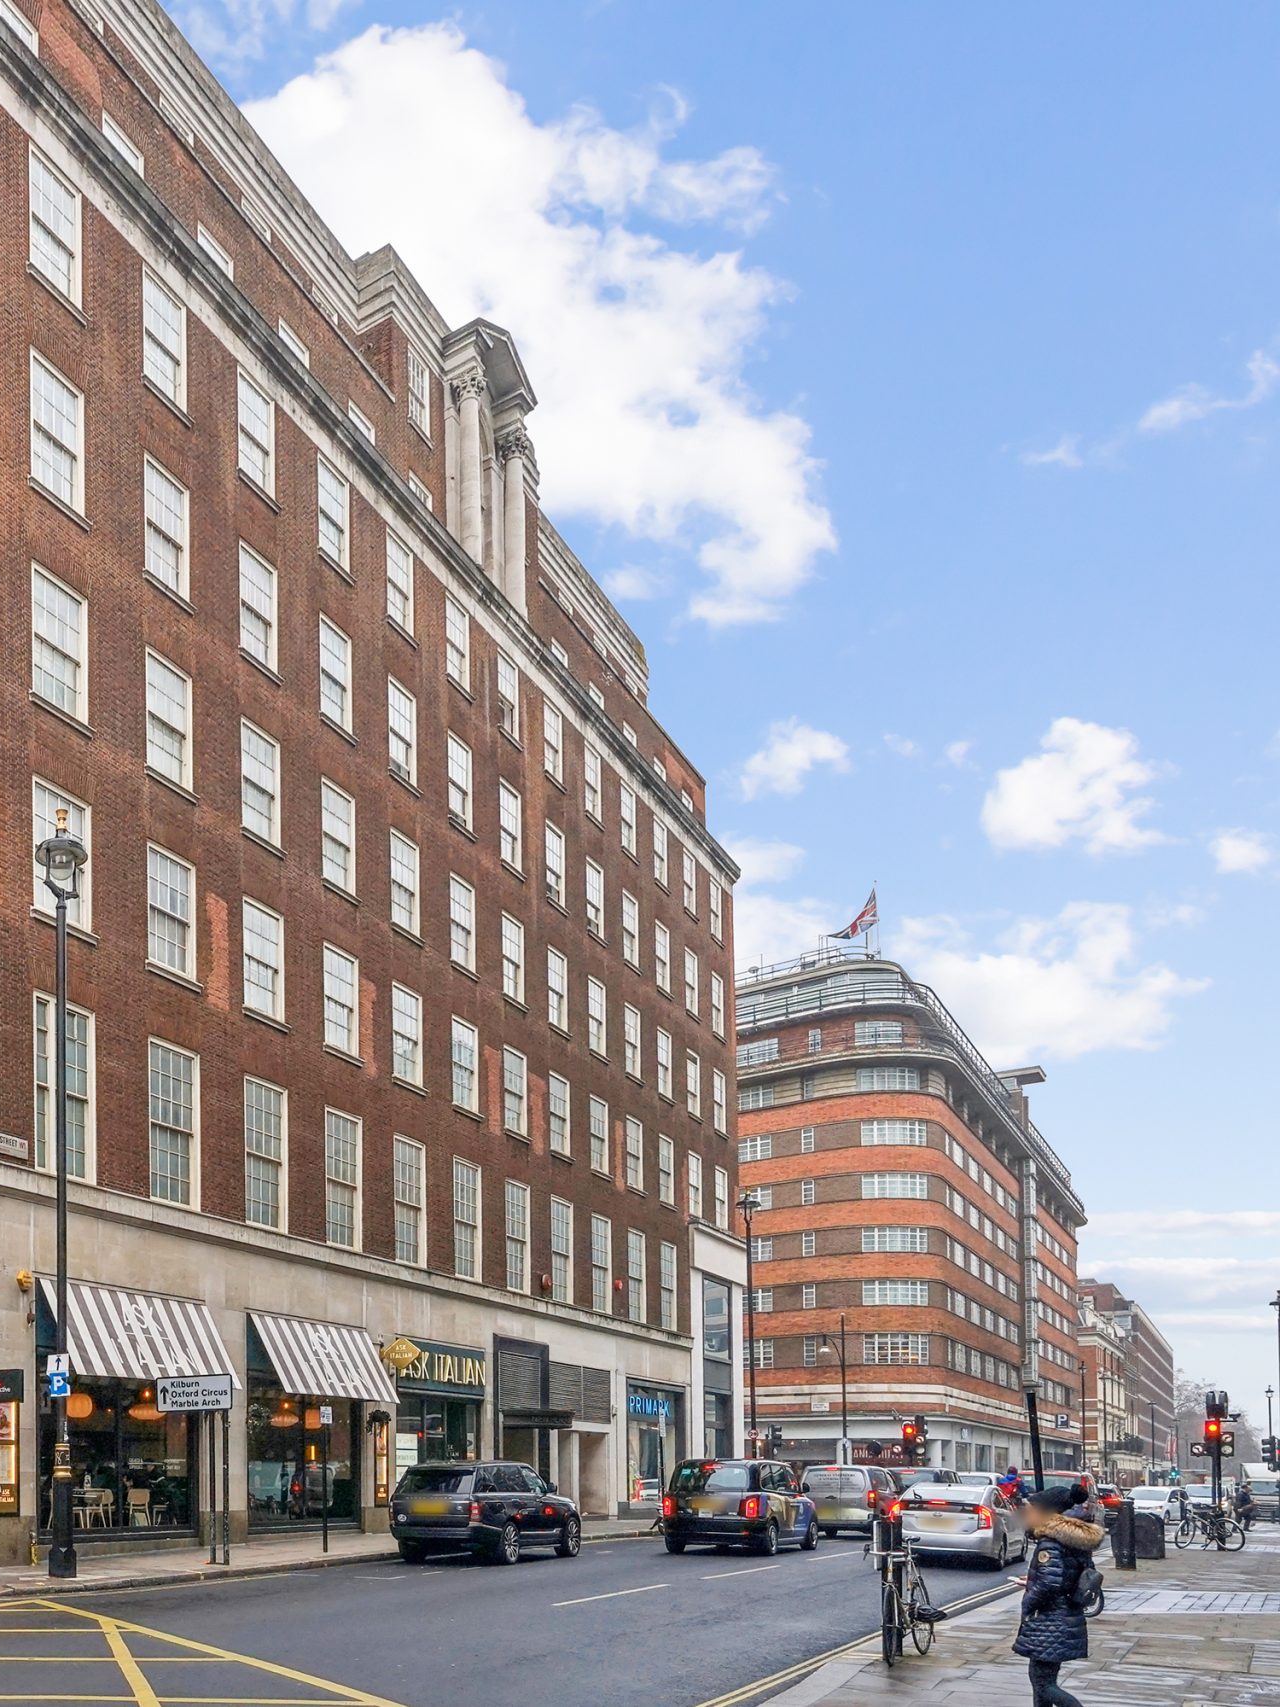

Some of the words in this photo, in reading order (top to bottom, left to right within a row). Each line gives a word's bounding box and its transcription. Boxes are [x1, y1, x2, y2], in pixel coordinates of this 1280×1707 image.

[0, 1135, 18, 1147] STREET
[122, 1304, 163, 1332] ASK
[400, 1352, 430, 1380] ASK
[433, 1353, 486, 1387] ITALIAN
[53, 1376, 65, 1391] P
[170, 1381, 200, 1389] Kilburn
[171, 1389, 199, 1398] Oxford
[201, 1389, 228, 1397] Circus
[171, 1399, 199, 1408] Marble
[629, 1396, 670, 1416] PRIMARK
[1057, 1415, 1067, 1425] P
